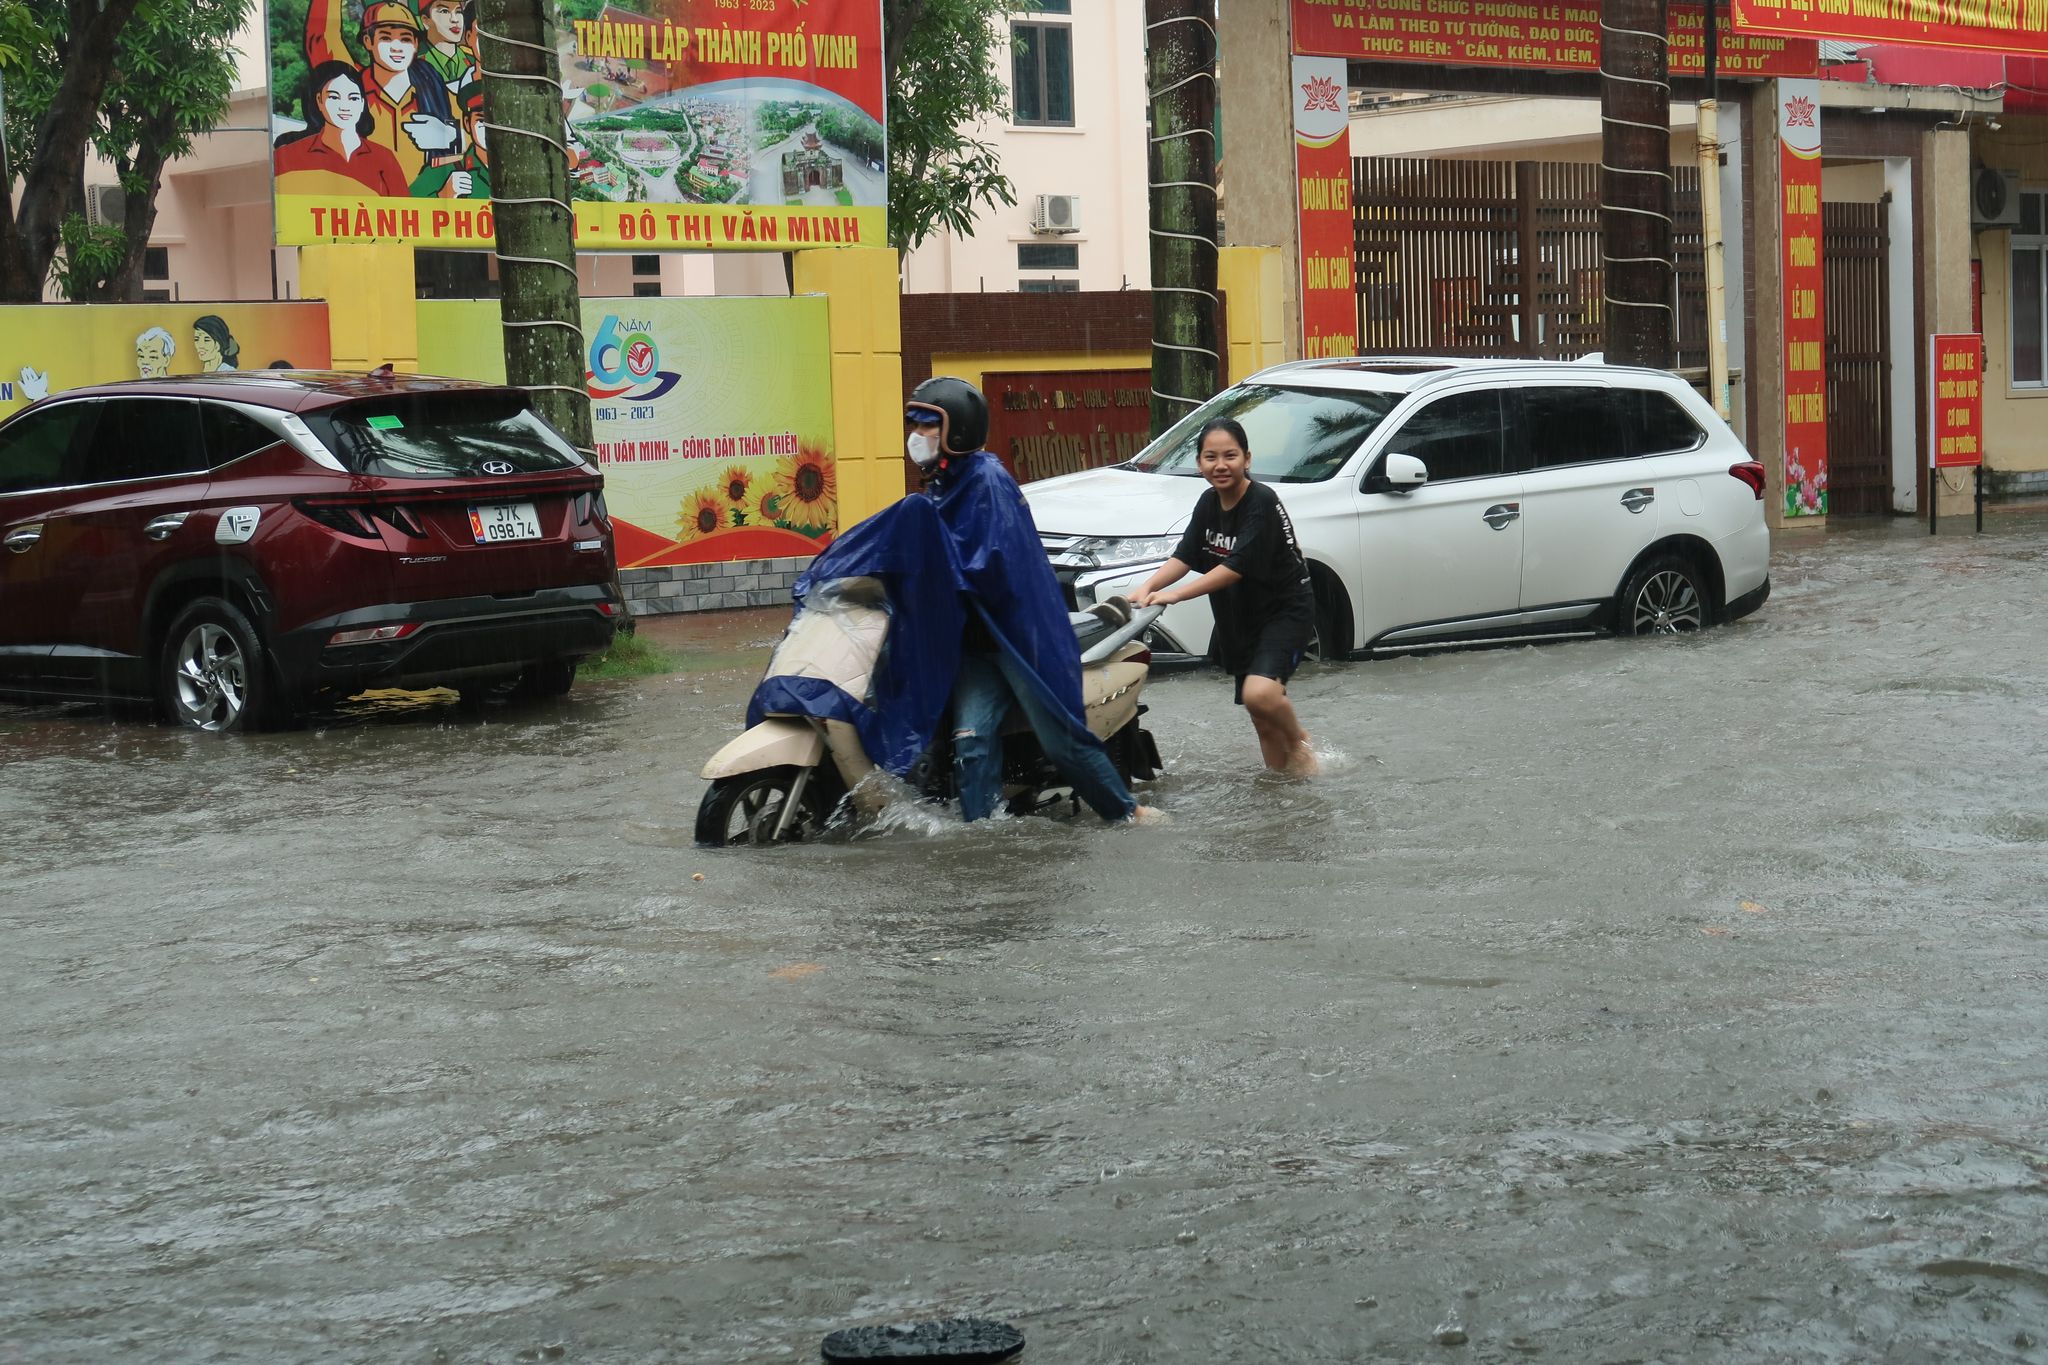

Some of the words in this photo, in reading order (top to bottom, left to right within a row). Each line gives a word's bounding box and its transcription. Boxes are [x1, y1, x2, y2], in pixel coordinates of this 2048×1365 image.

[714, 0, 739, 9] 1963
[750, 0, 775, 11] 2023
[1475, 2, 1538, 20] PHƯỜNG
[1543, 5, 1560, 21] LÊ
[1565, 8, 1598, 23] MAO
[574, 15, 645, 60] THÀNH
[650, 18, 690, 69] LẬP
[695, 22, 762, 65] THÀNH
[767, 21, 807, 68] PHỐ
[812, 34, 858, 69] VINH
[1332, 12, 1354, 28] VÀ
[1359, 13, 1395, 31] LÀM
[1400, 18, 1440, 34] THEO
[1445, 21, 1465, 36] TƯ
[1530, 26, 1560, 43] ĐẠO
[1565, 27, 1599, 44] ĐỨC,
[1668, 31, 1695, 47] ÁCH
[1722, 35, 1745, 49] CHÍ
[1362, 37, 1404, 55] THỰC
[1409, 38, 1452, 57] HIỆN:
[1508, 44, 1551, 63] KIỆM,
[1556, 47, 1597, 64] LIÊM,
[1724, 54, 1742, 69] VÔ
[1302, 170, 1329, 210] ĐOÀN
[1331, 168, 1349, 210] KẾT
[311, 202, 420, 237] THÀNH
[432, 201, 495, 239] PHỐ
[619, 208, 657, 241] ĐÔ
[667, 214, 713, 247] THỊ
[722, 210, 777, 243] VĂN
[788, 216, 861, 243] MINH
[1307, 250, 1328, 289] DÂN
[1330, 246, 1350, 289] CHỦ
[1792, 282, 1800, 319] LÊ
[618, 318, 652, 332] NĂM
[590, 314, 659, 384] 60
[596, 407, 617, 420] 1963
[631, 406, 654, 419] 2023
[614, 439, 635, 463] VĂN
[640, 440, 669, 461] MINH
[682, 435, 711, 459] CÔNG
[714, 434, 736, 457] DÂN
[739, 433, 765, 456] THÂN
[768, 431, 798, 458] THIỆN
[494, 505, 520, 521] 37K
[489, 522, 535, 540] 098.74
